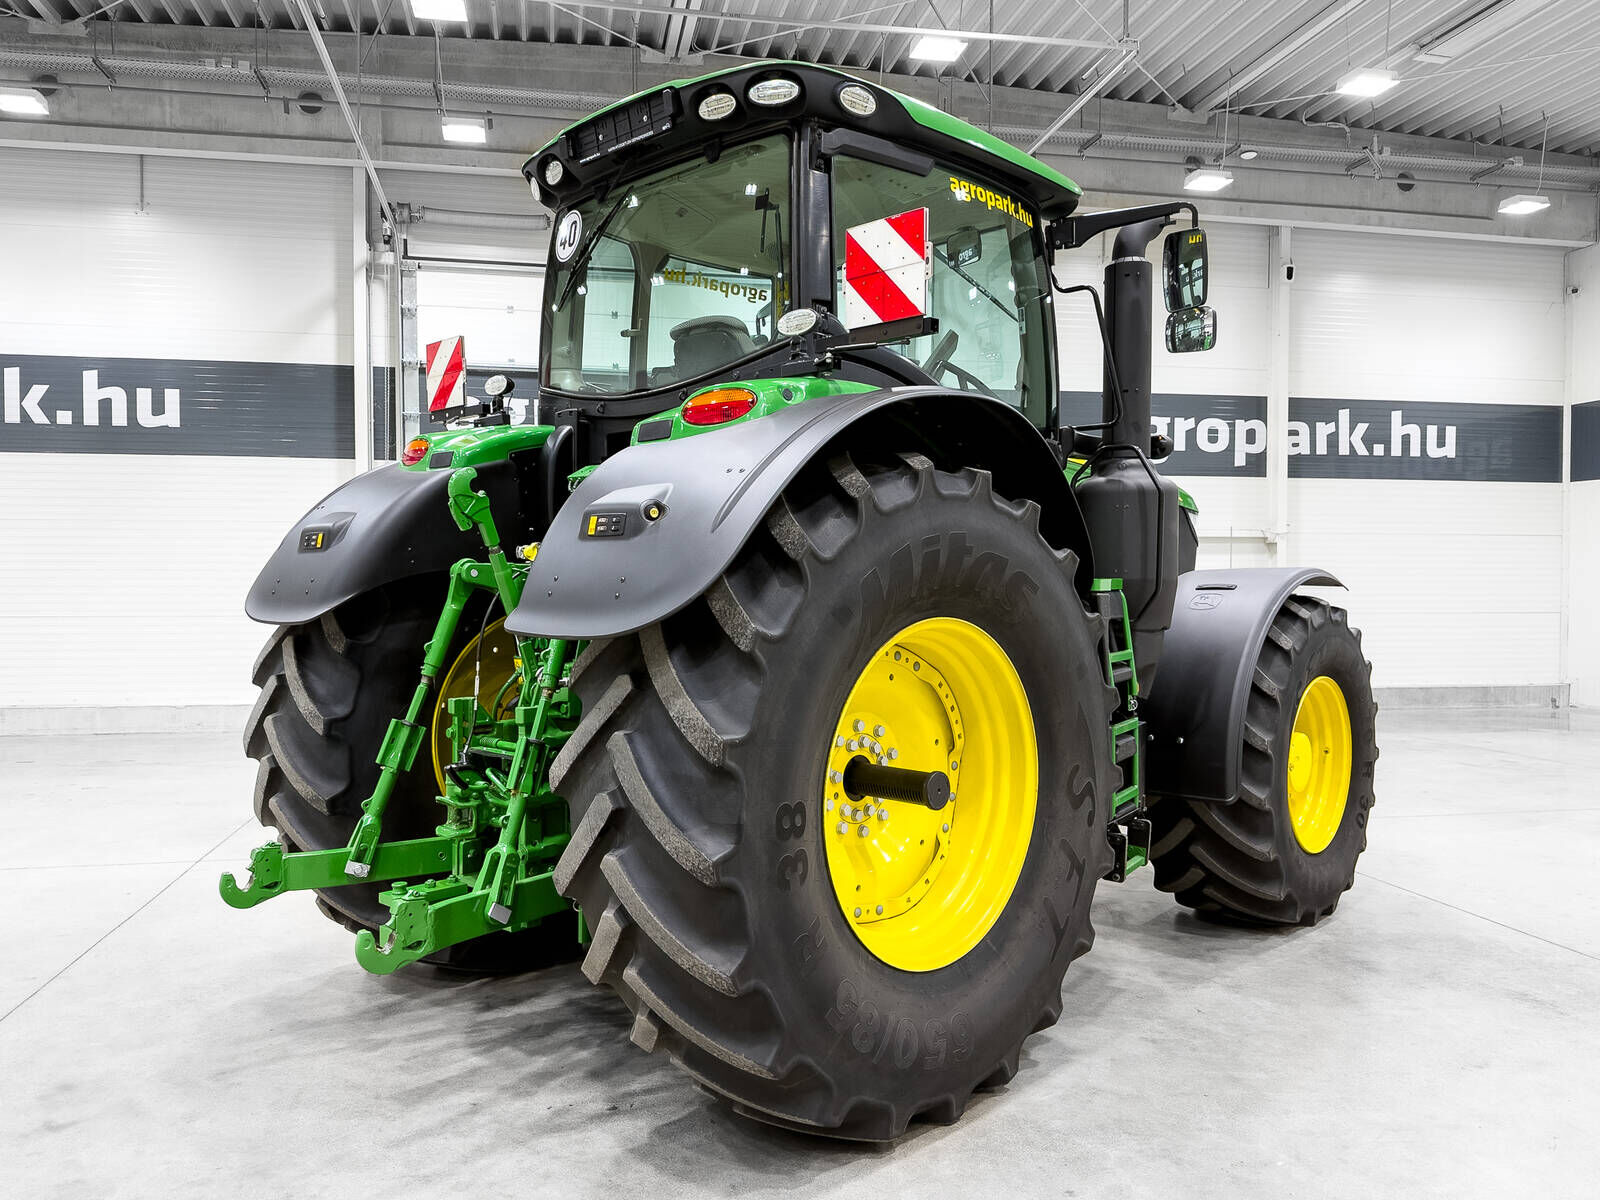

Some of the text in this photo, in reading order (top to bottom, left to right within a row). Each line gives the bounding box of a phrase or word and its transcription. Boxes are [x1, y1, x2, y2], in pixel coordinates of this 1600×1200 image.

[560, 220, 578, 250] 40
[949, 176, 1034, 228] agropark.hu
[859, 529, 1040, 638] Mitas
[775, 800, 808, 891] 38
[824, 978, 978, 1071] 650/85
